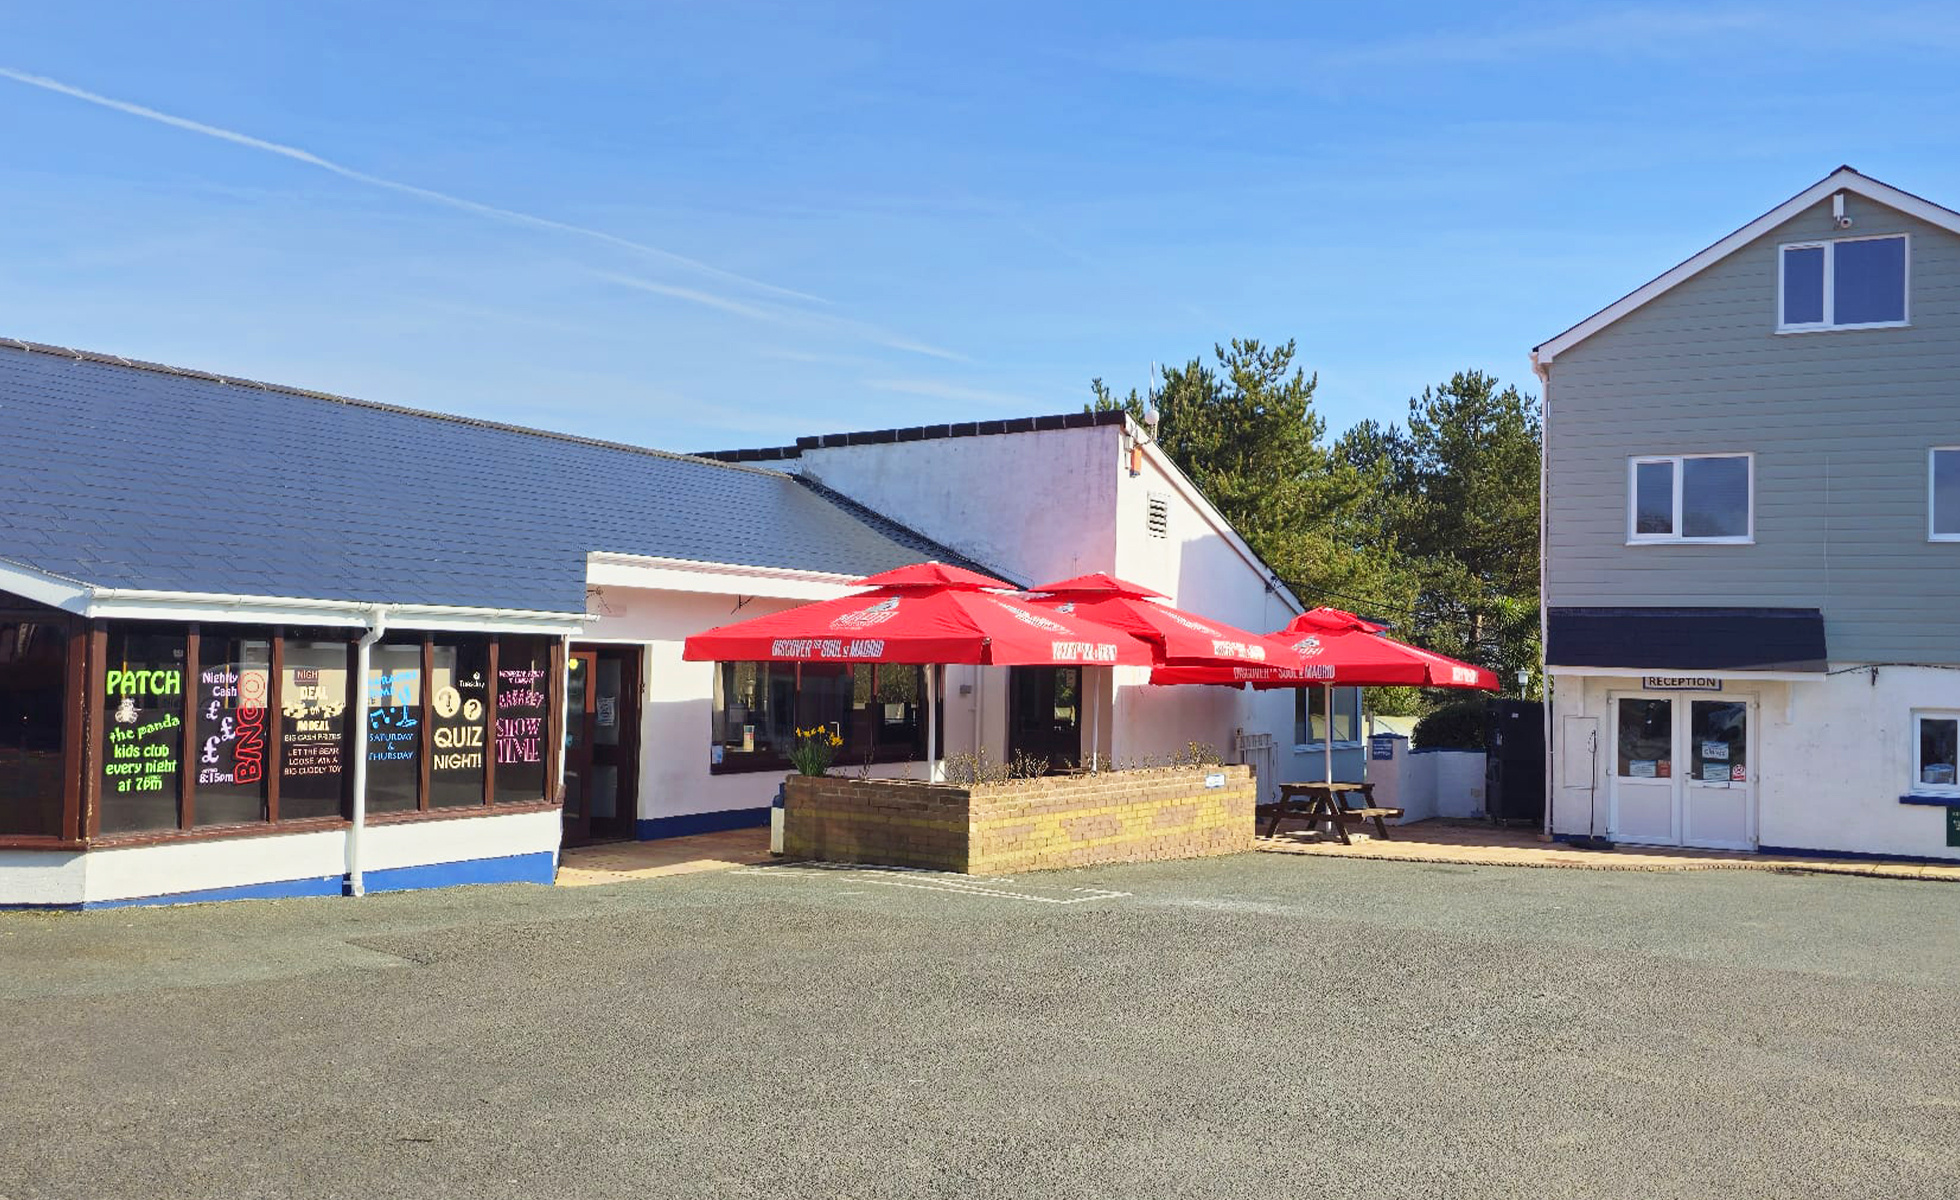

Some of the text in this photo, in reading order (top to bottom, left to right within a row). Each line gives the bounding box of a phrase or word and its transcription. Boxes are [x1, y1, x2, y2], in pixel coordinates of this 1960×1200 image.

[772, 639, 812, 657] DISCOVER
[821, 639, 841, 658] SOUL
[849, 639, 885, 658] MADRID
[106, 670, 181, 695] PATCH
[202, 671, 238, 684] Nightly
[1649, 676, 1716, 687] RECEPTION
[212, 686, 237, 697] Cash
[109, 713, 180, 743] the panda
[234, 672, 265, 784] BINGO
[309, 720, 330, 731] DEAL
[496, 717, 542, 737] SHOW
[284, 734, 296, 742] BIG
[297, 734, 317, 742] CASH
[369, 733, 413, 742] SATURDAY
[434, 726, 483, 748] QUIZ
[114, 744, 170, 758] kids club
[304, 747, 317, 756] THE
[368, 751, 414, 761] THURSDAY
[496, 737, 541, 763] TIME
[105, 759, 177, 775] every night
[433, 753, 482, 770] NIGHT!
[329, 765, 342, 773] TOY
[117, 778, 132, 792] at
